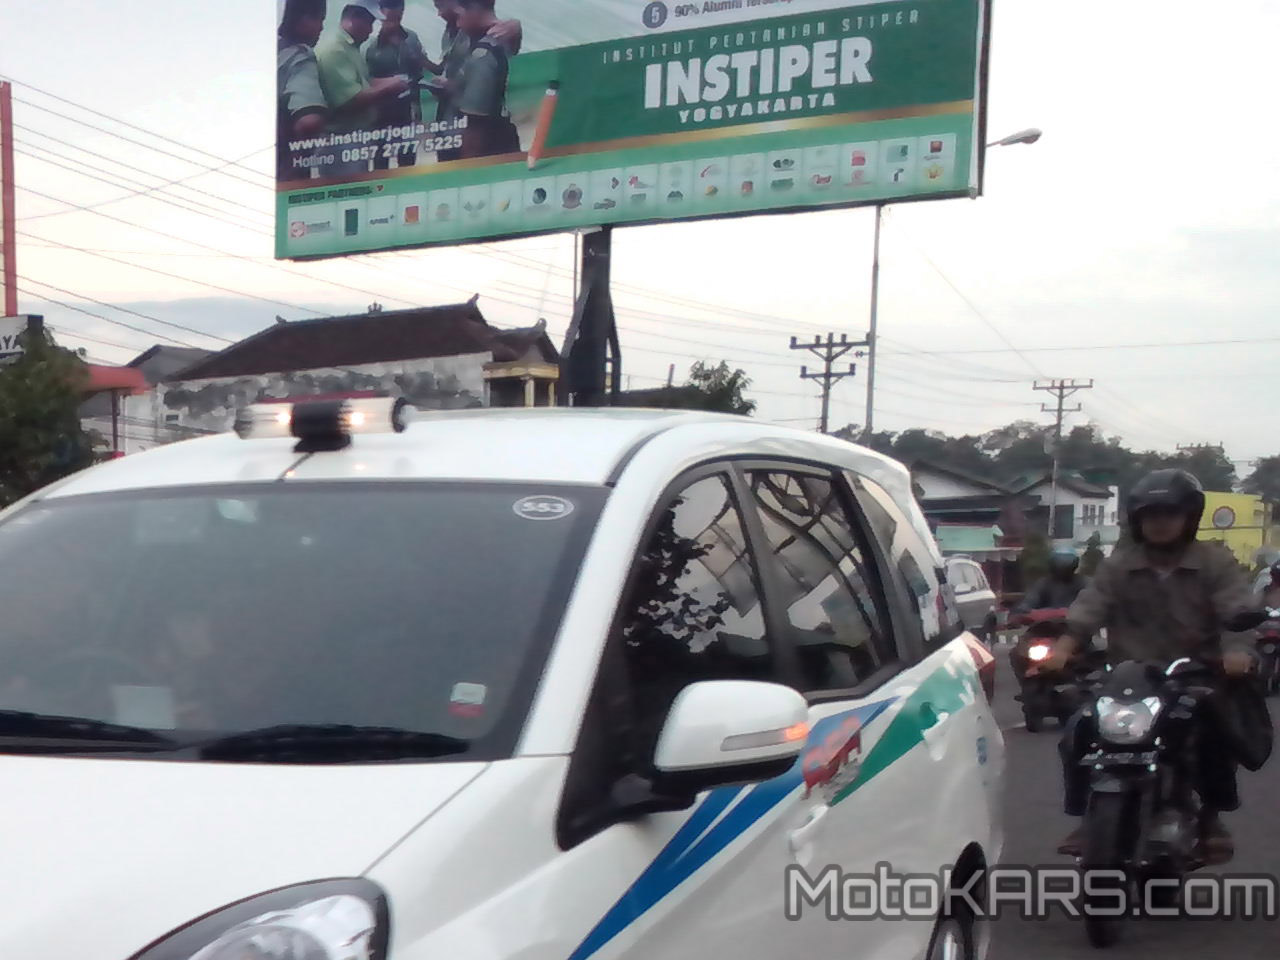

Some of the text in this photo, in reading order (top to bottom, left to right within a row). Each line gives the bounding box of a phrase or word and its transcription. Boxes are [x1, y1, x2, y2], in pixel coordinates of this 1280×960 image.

[674, 4, 699, 17] 90%
[603, 10, 919, 64] INSTITUT PERTANIAN STIPER
[644, 36, 873, 109] INSTIPER
[679, 92, 836, 124] YOGYAKARTA
[288, 116, 468, 151] www.instiperjogja.ac.id
[292, 135, 463, 168] Hotline 0857 2777 5225
